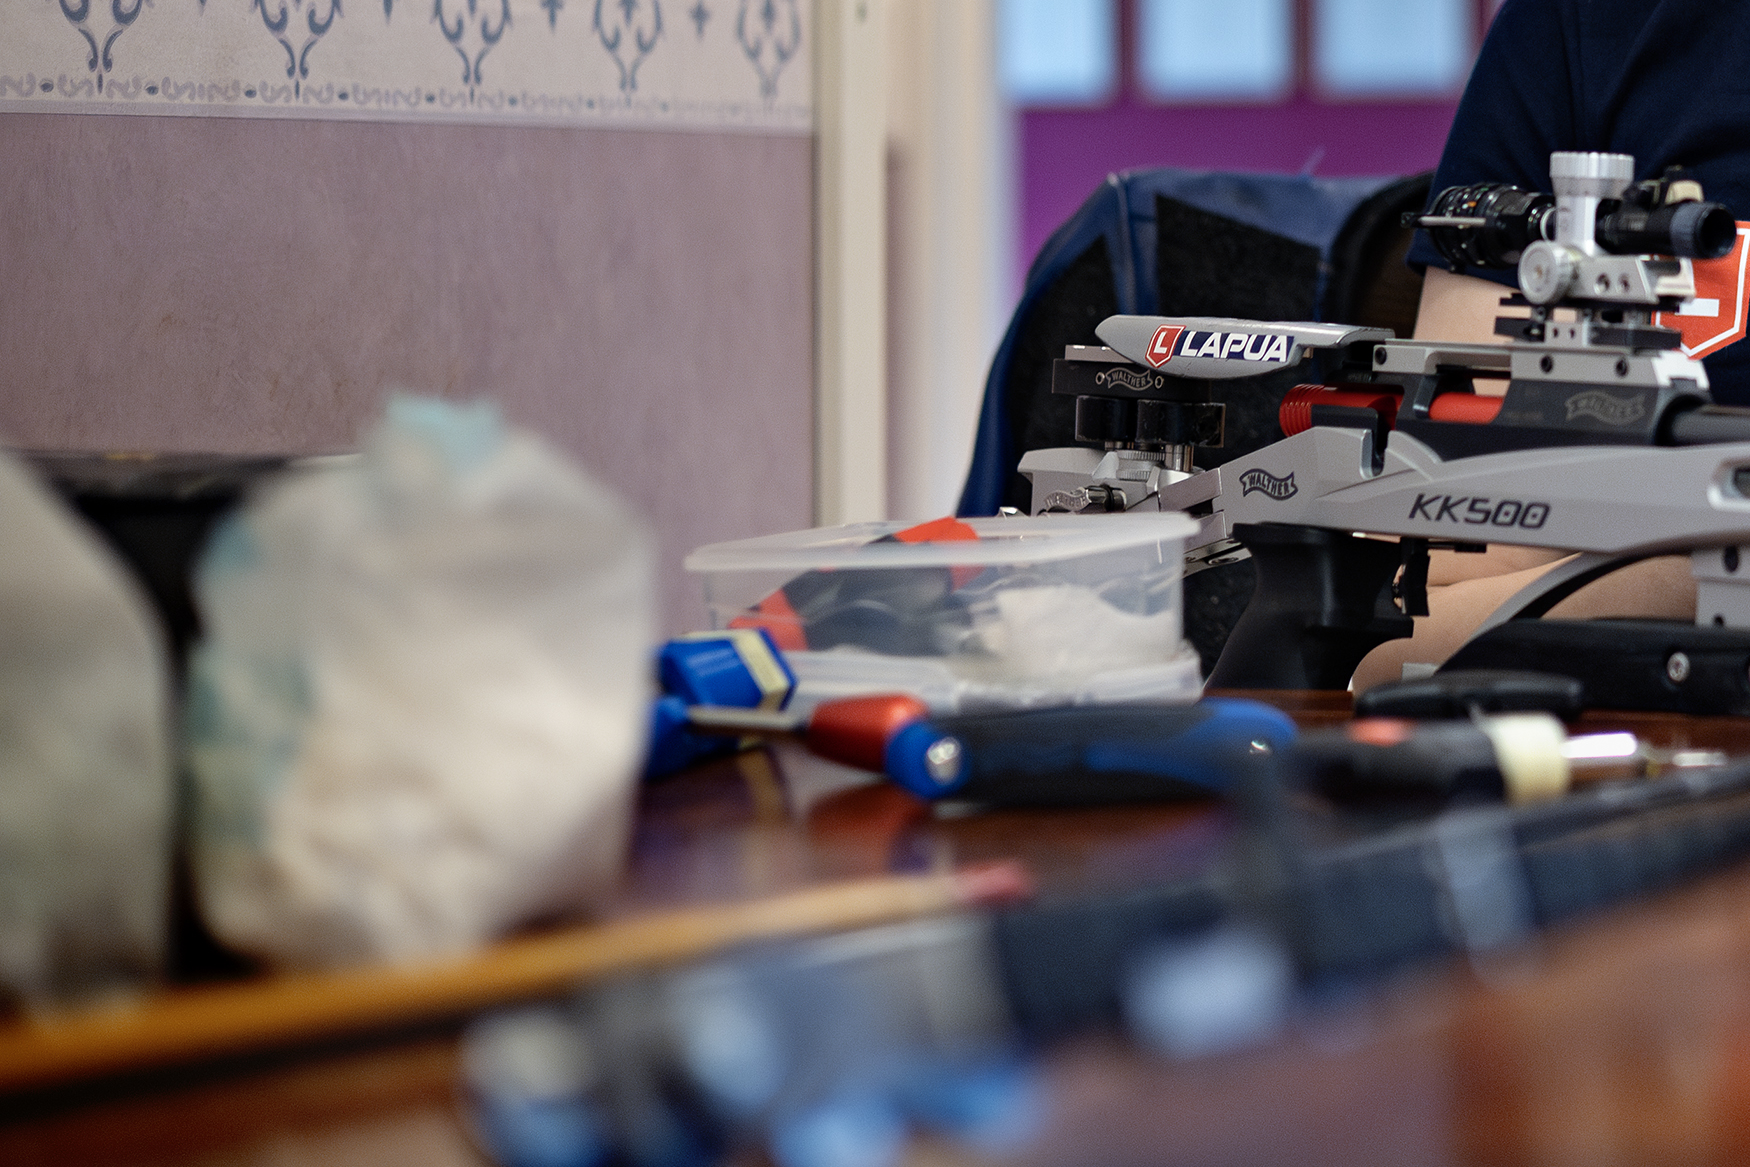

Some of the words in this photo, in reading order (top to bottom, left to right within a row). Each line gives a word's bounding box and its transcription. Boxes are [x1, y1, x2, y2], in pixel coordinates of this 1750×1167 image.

[1179, 330, 1288, 363] LAPUA
[1112, 370, 1147, 389] WALTHER
[1247, 471, 1290, 497] WALTHER
[1408, 493, 1551, 530] KK500
